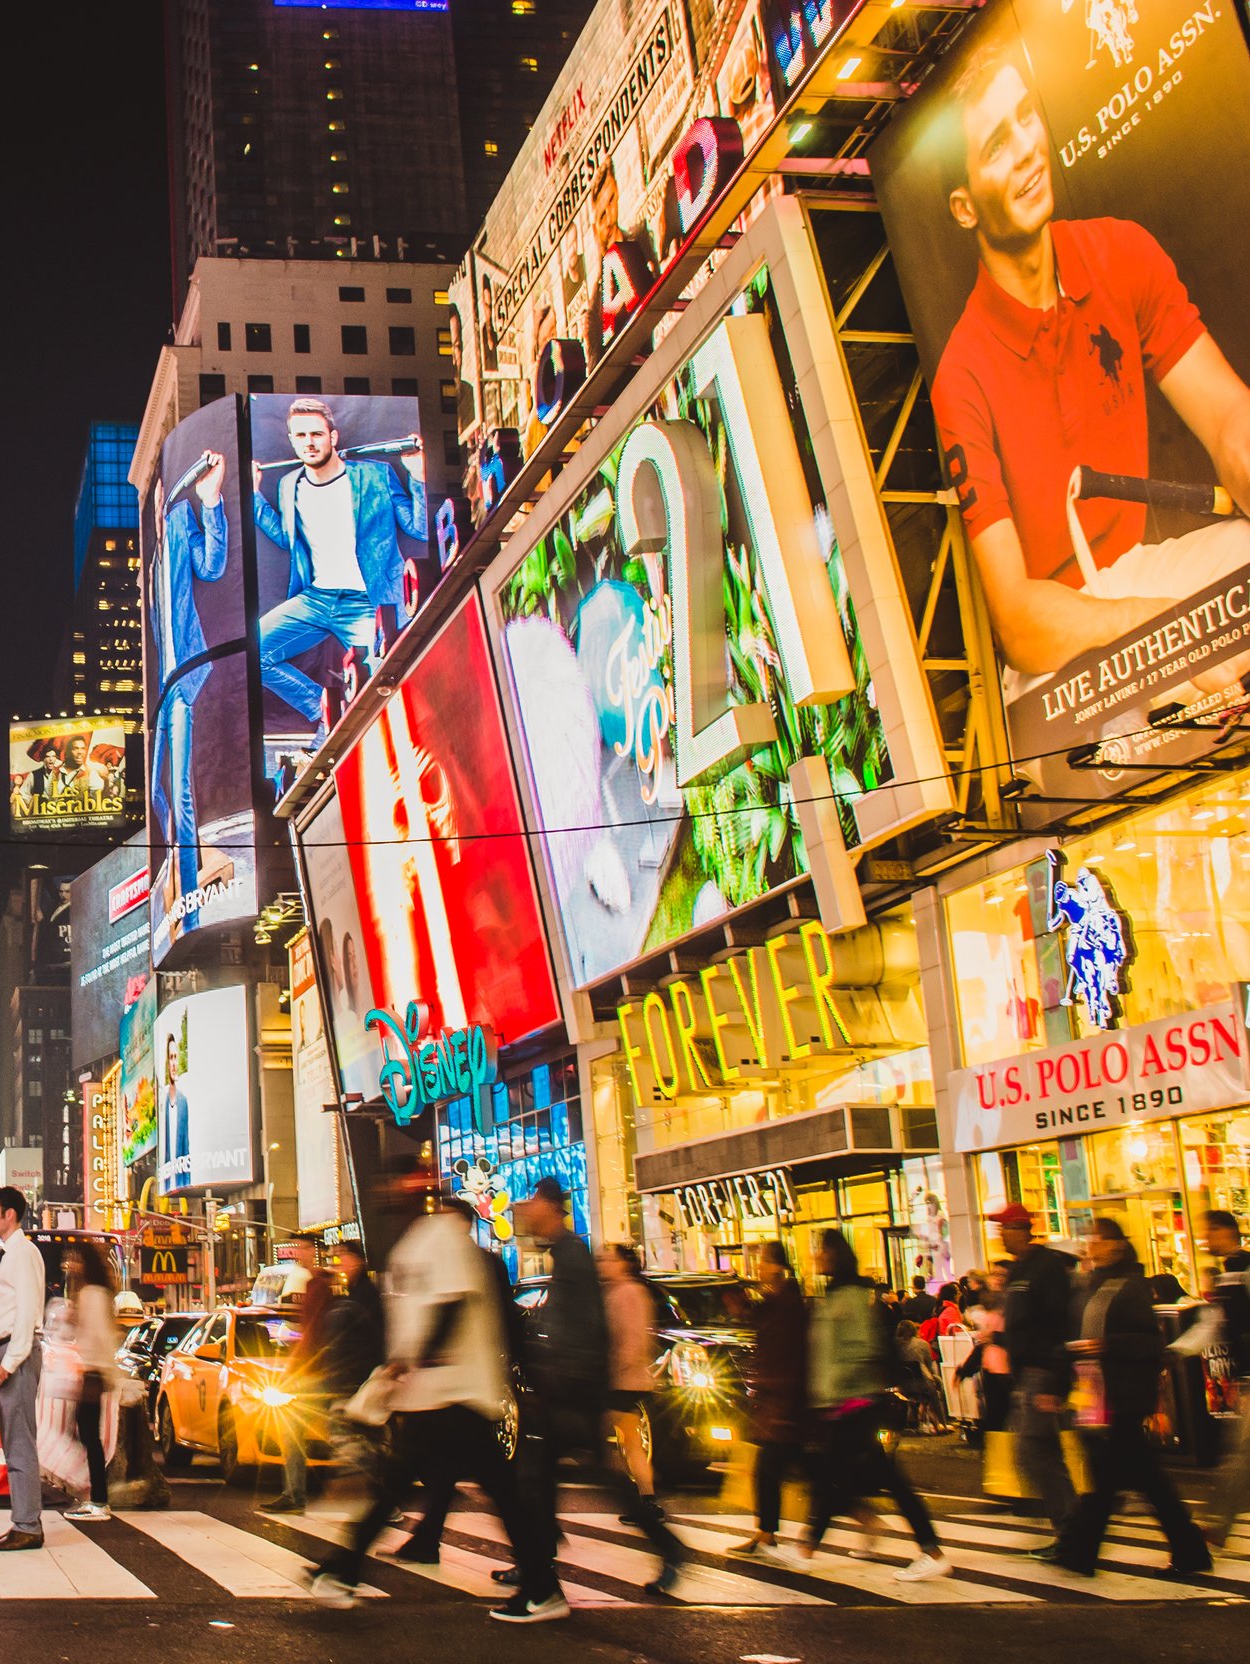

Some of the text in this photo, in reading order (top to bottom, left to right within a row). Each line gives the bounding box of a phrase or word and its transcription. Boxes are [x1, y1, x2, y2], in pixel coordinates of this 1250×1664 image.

[1059, 0, 1222, 168] U.S. POLO ASSN.
[1097, 70, 1183, 159] SINCE 1890
[543, 79, 586, 178] NETFLIX
[494, 230, 547, 333] SPECIAL
[547, 25, 669, 246] CORRESPONDENTS
[1041, 669, 1095, 722] LIVE
[1074, 700, 1104, 724] JONNY
[1103, 680, 1140, 708] LAVINE
[1146, 671, 1158, 686] 17
[1159, 654, 1188, 679] YEAR
[1187, 643, 1211, 665] OLD
[1211, 627, 1243, 652] POLO
[1184, 682, 1243, 718] SEALED SIN
[14, 789, 123, 818] Misérables
[51, 779, 80, 798] Les
[185, 878, 243, 914] BRYANT
[616, 919, 854, 1108] FOREVER
[975, 1013, 1242, 1110] U.S. POLO ASSN
[1035, 1085, 1184, 1130] SINCE 1890
[11, 1169, 42, 1178] Switch
[673, 1168, 796, 1229] FOREVER 21
